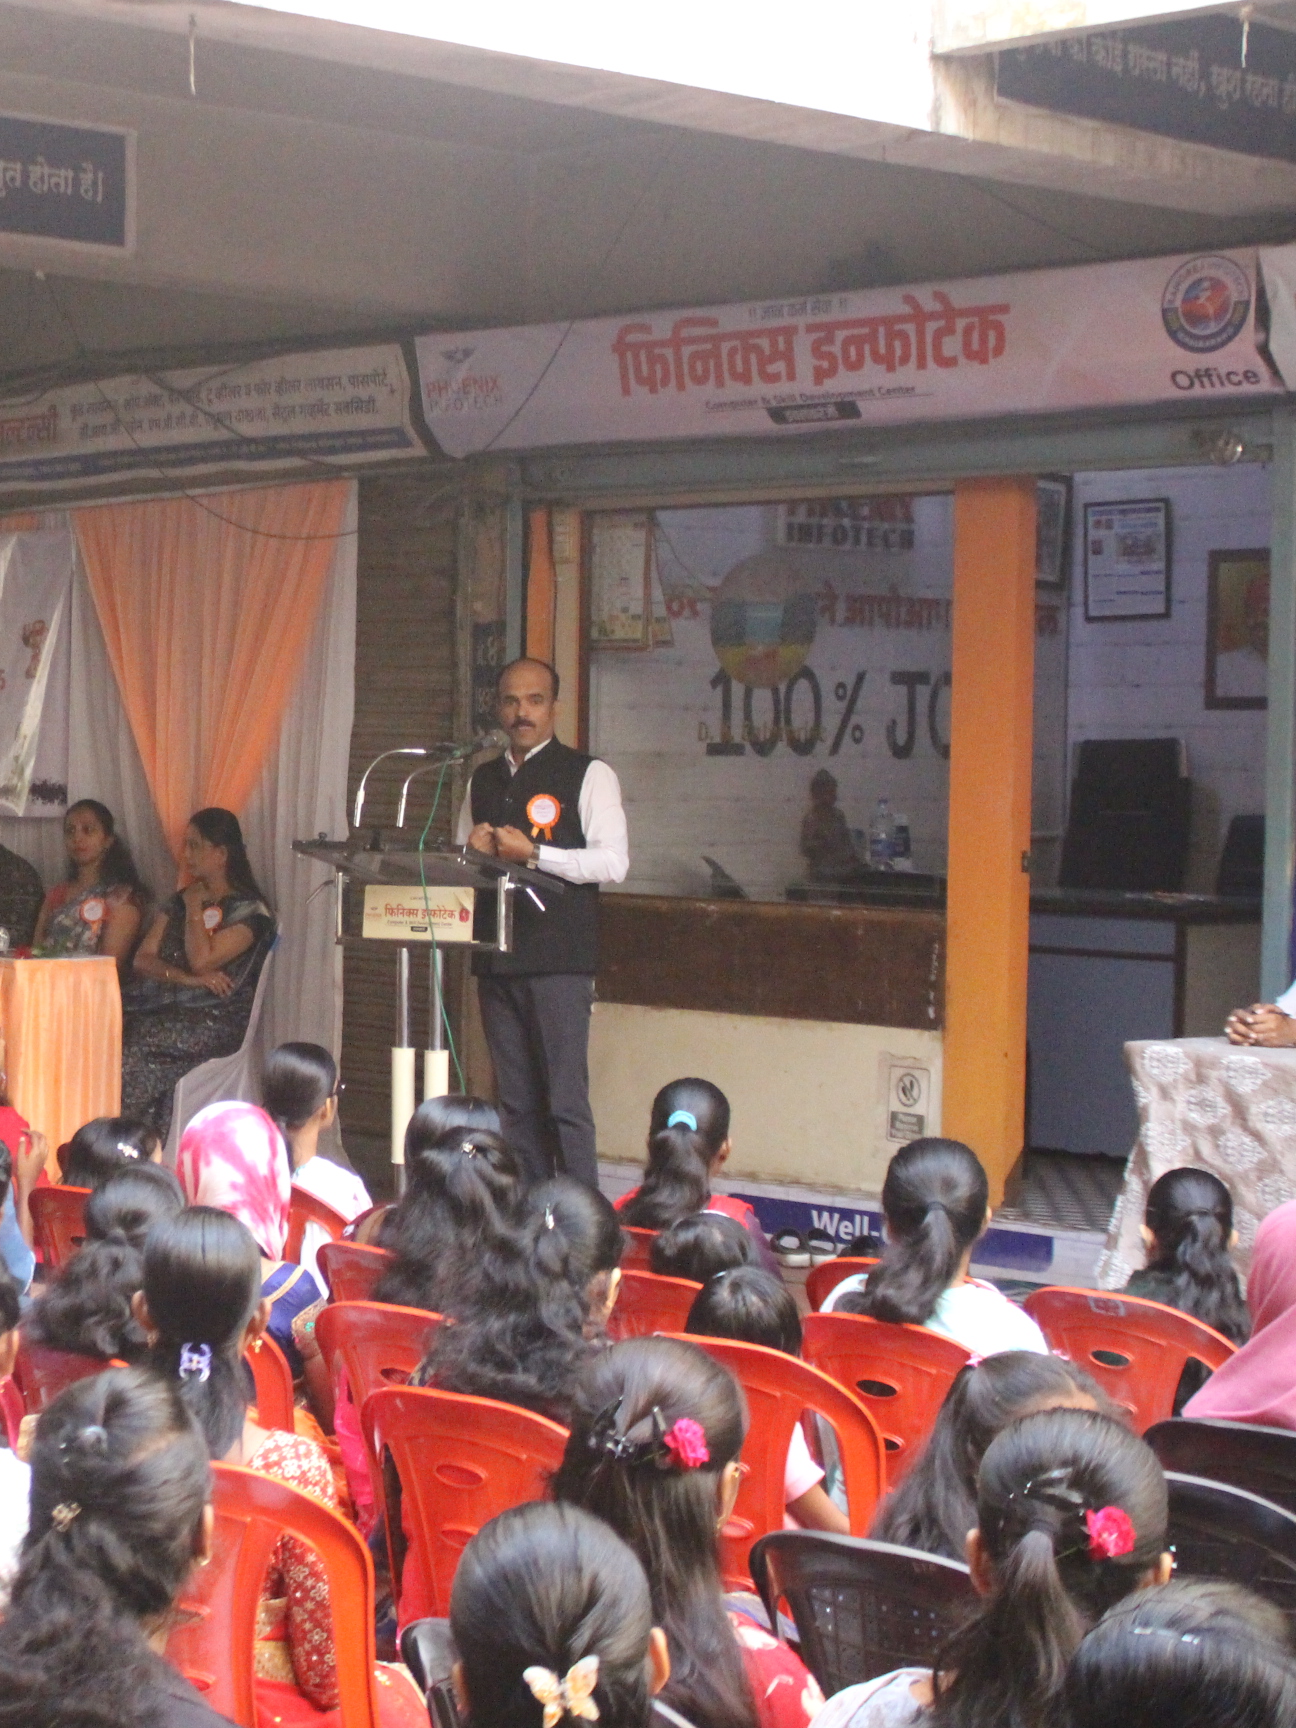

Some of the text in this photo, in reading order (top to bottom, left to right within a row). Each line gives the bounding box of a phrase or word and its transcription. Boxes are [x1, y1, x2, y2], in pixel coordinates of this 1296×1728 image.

[29, 154, 74, 196] होता
[612, 290, 1010, 397] फिनिक्स इन्फोटेक
[1171, 368, 1261, 391] Office
[705, 399, 758, 410] Computer
[774, 393, 796, 405] Skill
[800, 389, 875, 405] Development
[878, 385, 915, 396] Center
[786, 523, 915, 549] INFOTECH
[705, 665, 865, 760] 100%
[384, 903, 419, 918] फिनिक्स
